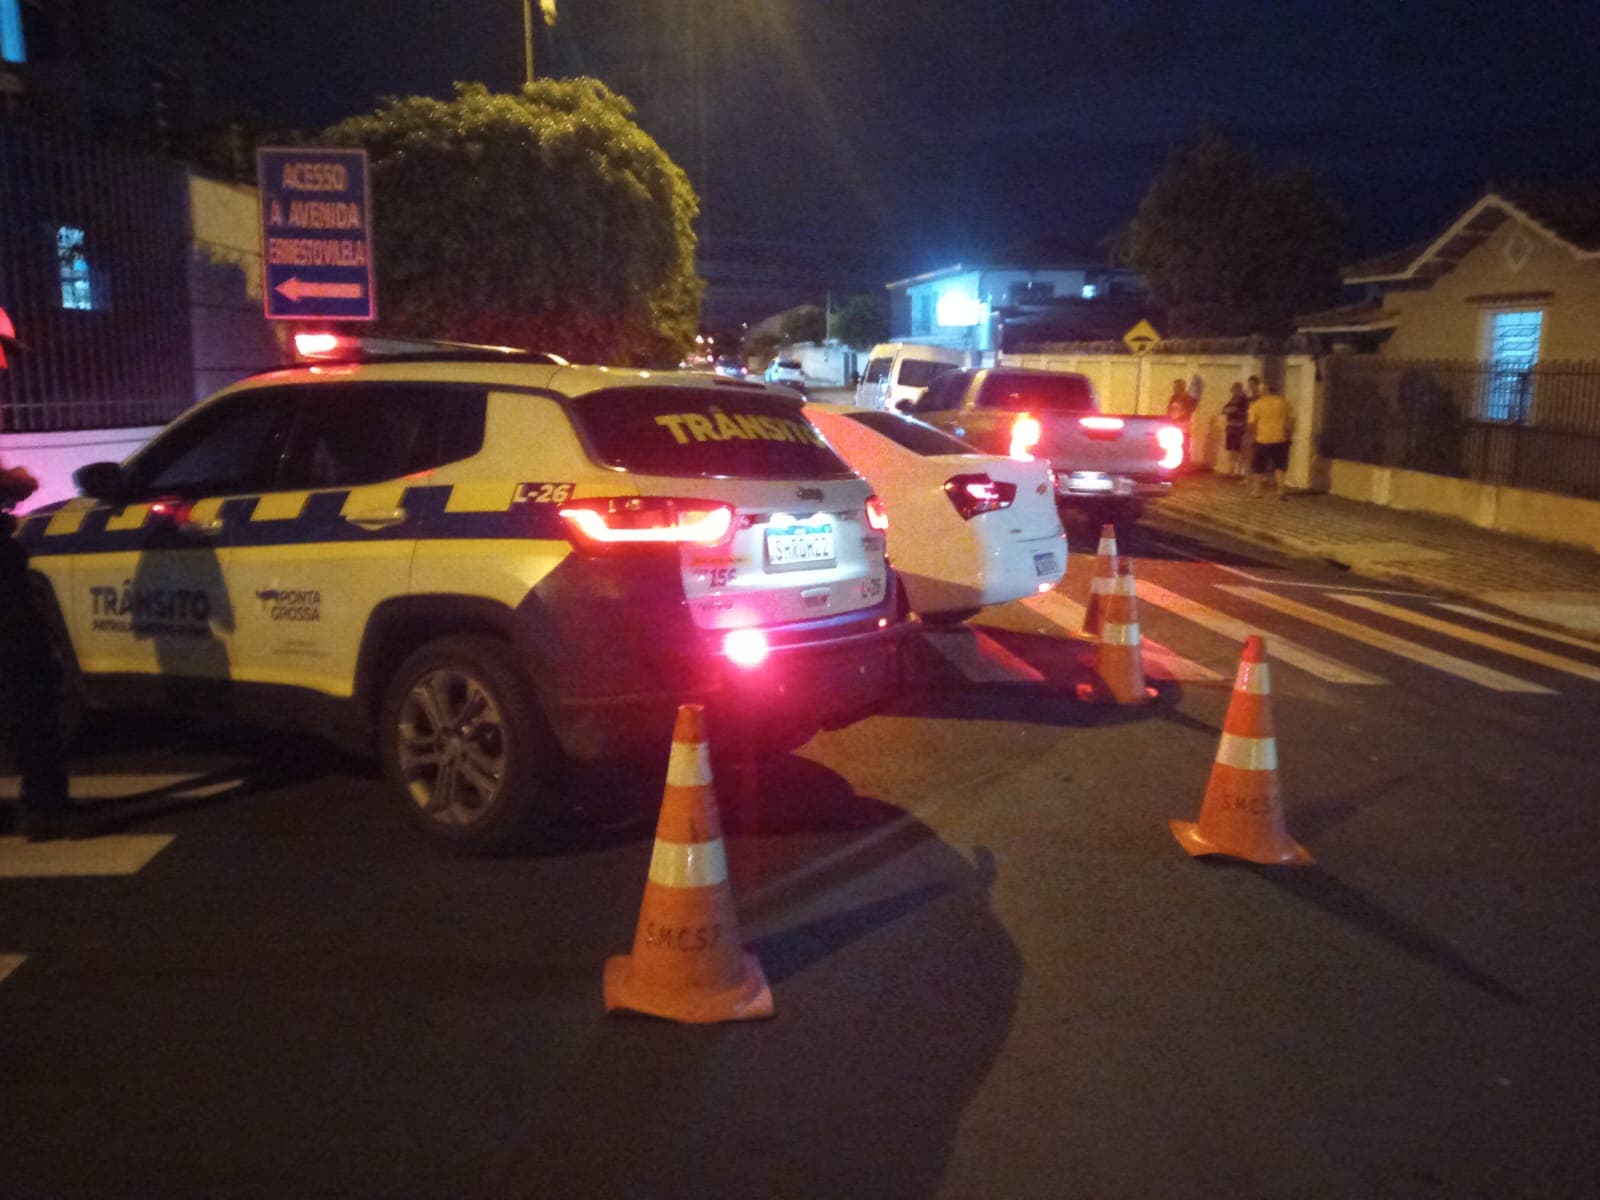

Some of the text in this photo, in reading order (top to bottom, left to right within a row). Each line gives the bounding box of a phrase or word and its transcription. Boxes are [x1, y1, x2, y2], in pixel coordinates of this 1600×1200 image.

[283, 163, 348, 191] ACESSO
[288, 202, 360, 229] AVENIDA
[512, 483, 571, 503] L-26
[89, 580, 210, 621] TRÂNSITO
[278, 589, 322, 606] PONTA
[270, 604, 321, 622] GROSSA
